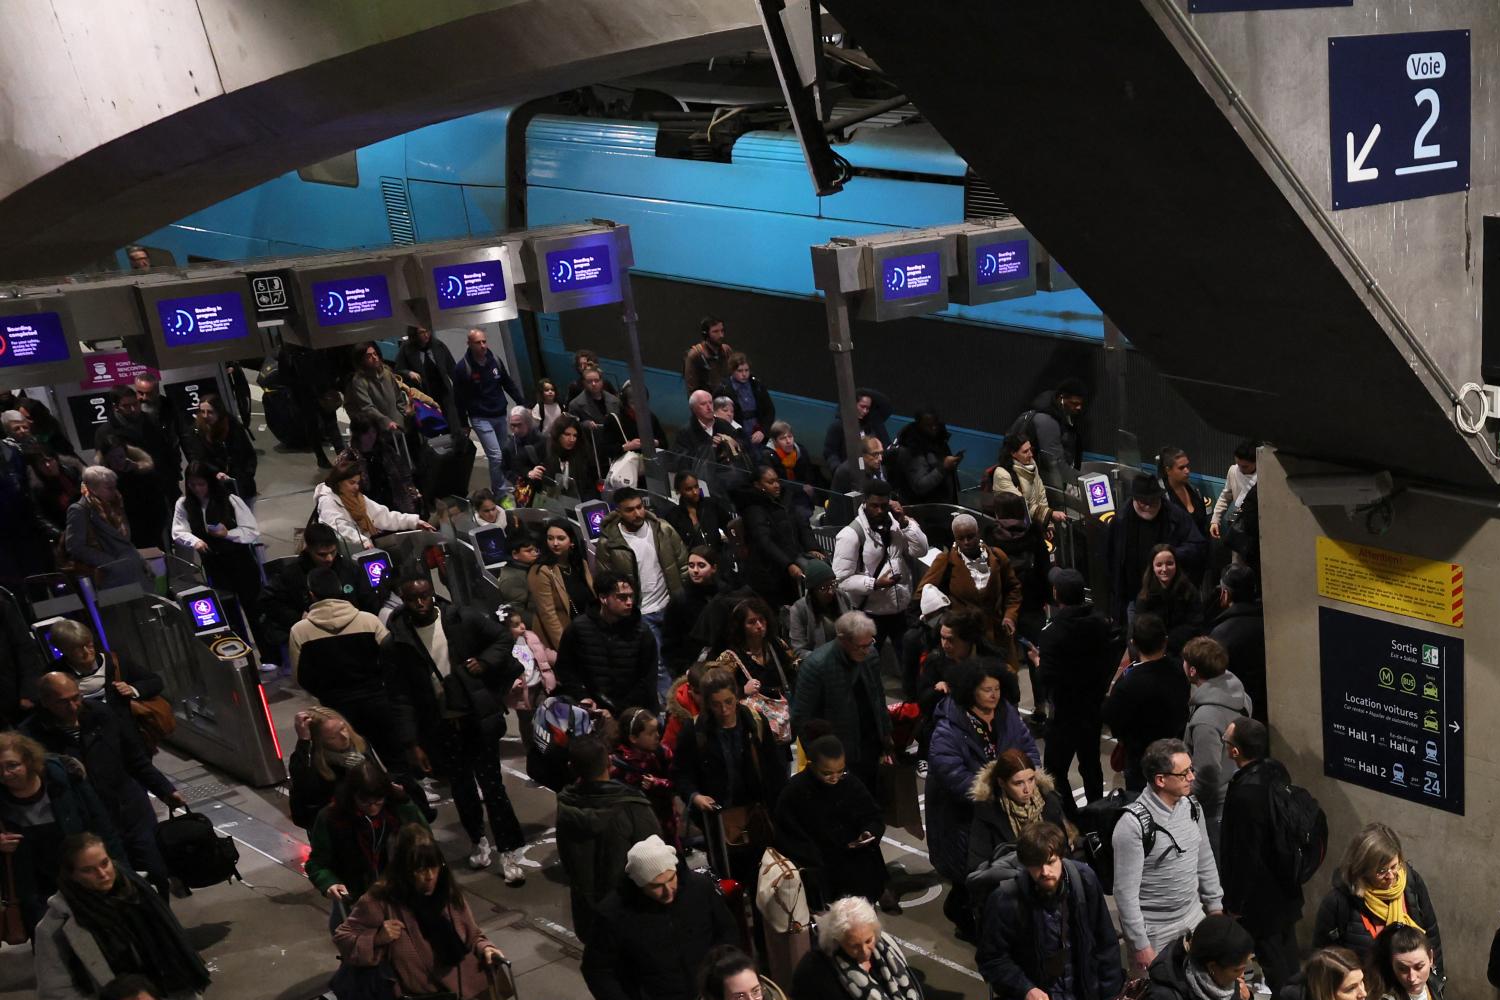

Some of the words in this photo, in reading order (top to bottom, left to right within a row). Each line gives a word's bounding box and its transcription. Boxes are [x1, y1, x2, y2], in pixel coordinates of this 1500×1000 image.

[1412, 57, 1440, 76] Voie
[1414, 88, 1440, 159] 2
[189, 392, 199, 406] 3
[95, 405, 107, 420] 2
[1391, 639, 1418, 655] Sortie
[1382, 671, 1391, 682] M
[1402, 677, 1414, 687] BUS
[1345, 691, 1382, 710] Location
[1383, 704, 1418, 720] voitures
[1333, 722, 1346, 731] vers
[1348, 727, 1368, 742] Hall
[1370, 734, 1376, 744] 1
[1390, 739, 1408, 753] Hall
[1409, 745, 1416, 755] 4
[1343, 756, 1356, 764] vers
[1358, 760, 1378, 776] Hall
[1380, 767, 1387, 778] 2
[1423, 777, 1440, 795] 24
